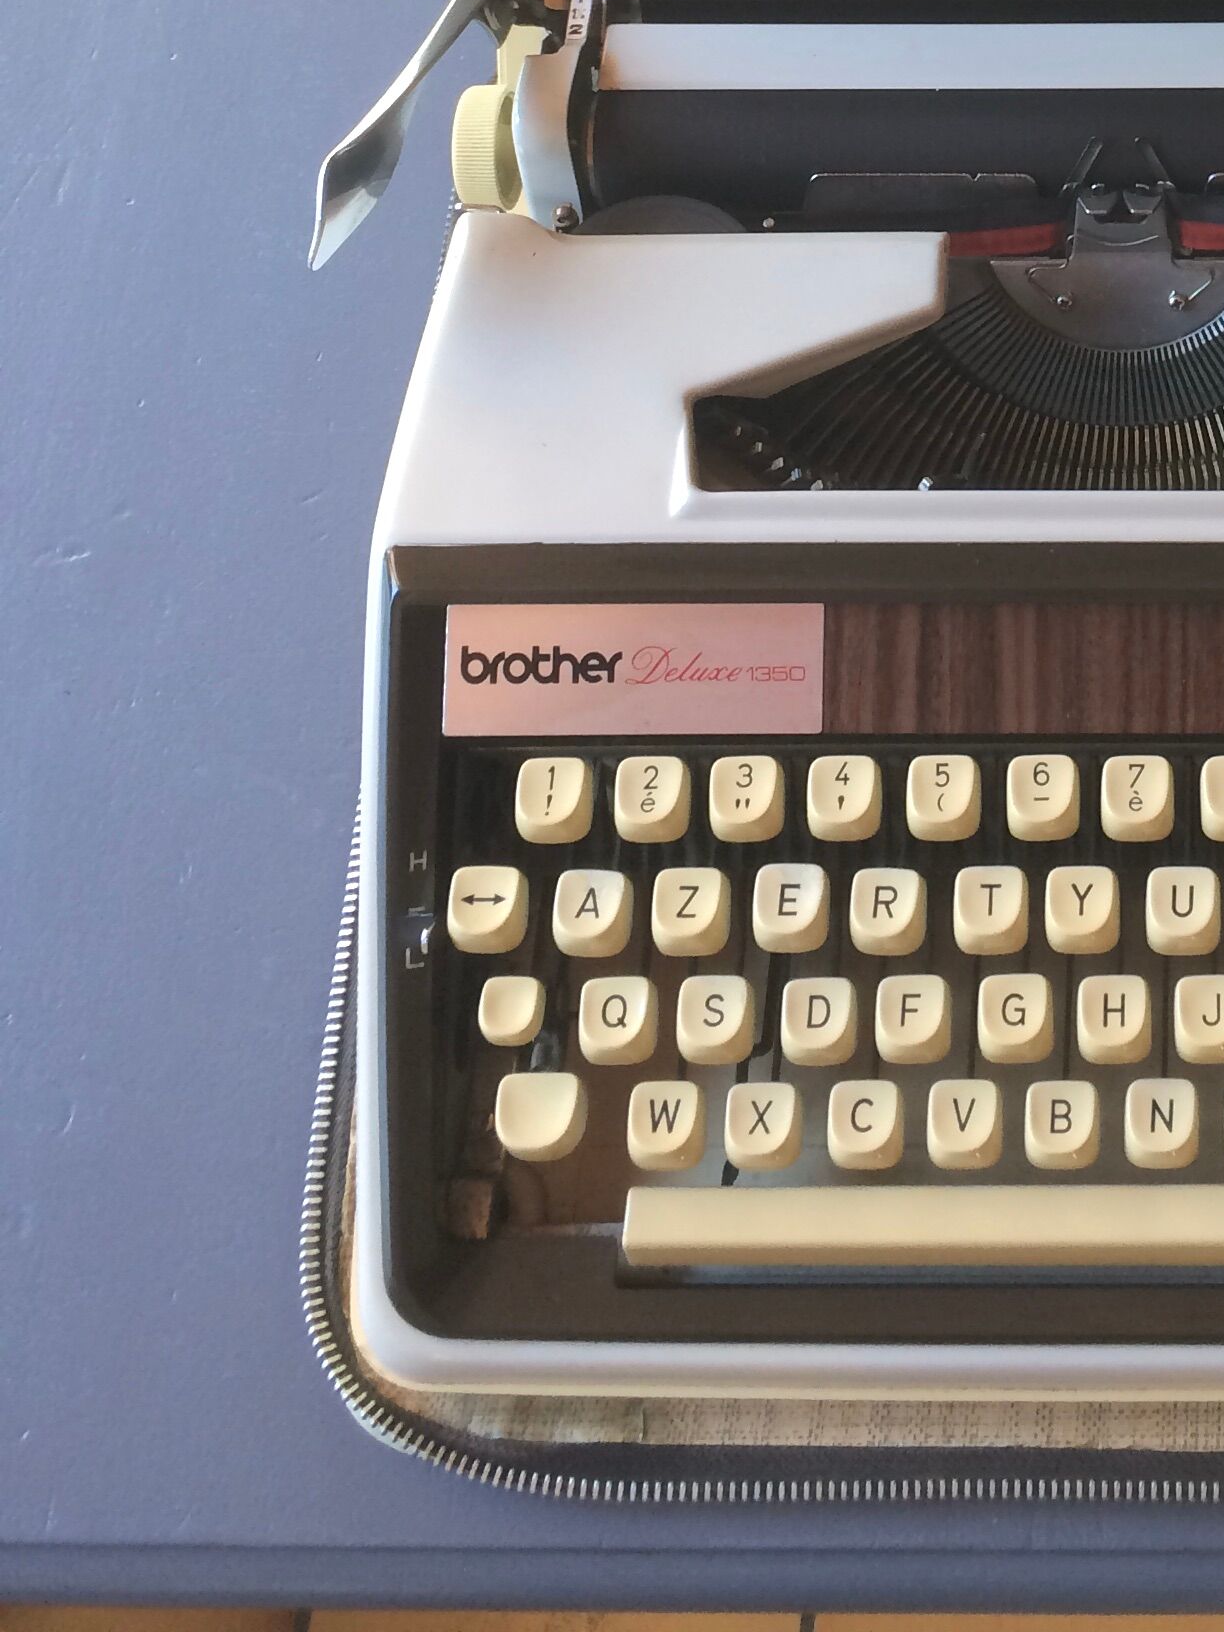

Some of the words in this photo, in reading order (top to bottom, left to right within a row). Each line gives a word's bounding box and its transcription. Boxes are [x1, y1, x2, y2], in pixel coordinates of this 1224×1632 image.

[568, 23, 583, 35] 2
[460, 645, 623, 685] brother
[625, 645, 741, 686] Deluxe
[749, 665, 806, 683] 1350
[643, 765, 659, 790] 2
[735, 763, 753, 789] 3
[834, 761, 850, 786] 4
[935, 762, 950, 788] 5
[1032, 761, 1050, 787] 6
[1128, 763, 1145, 789] 7
[639, 791, 656, 814] é
[1128, 789, 1144, 812] è
[409, 849, 427, 872] H
[574, 887, 600, 919] A
[675, 885, 700, 919] Z
[777, 883, 801, 917] E
[872, 885, 898, 919] R
[979, 883, 1002, 917] T
[1070, 882, 1094, 917] Y
[1171, 884, 1195, 918] U
[601, 994, 628, 1029] Q
[702, 993, 725, 1028] S
[806, 994, 831, 1029] D
[900, 993, 922, 1028] F
[1001, 992, 1026, 1027] G
[1102, 992, 1126, 1028] H
[1201, 992, 1221, 1027] J
[649, 1098, 682, 1134] W
[748, 1100, 773, 1135] X
[850, 1097, 874, 1133] C
[952, 1097, 976, 1133] V
[1049, 1098, 1072, 1134] B
[1150, 1097, 1174, 1133] N
